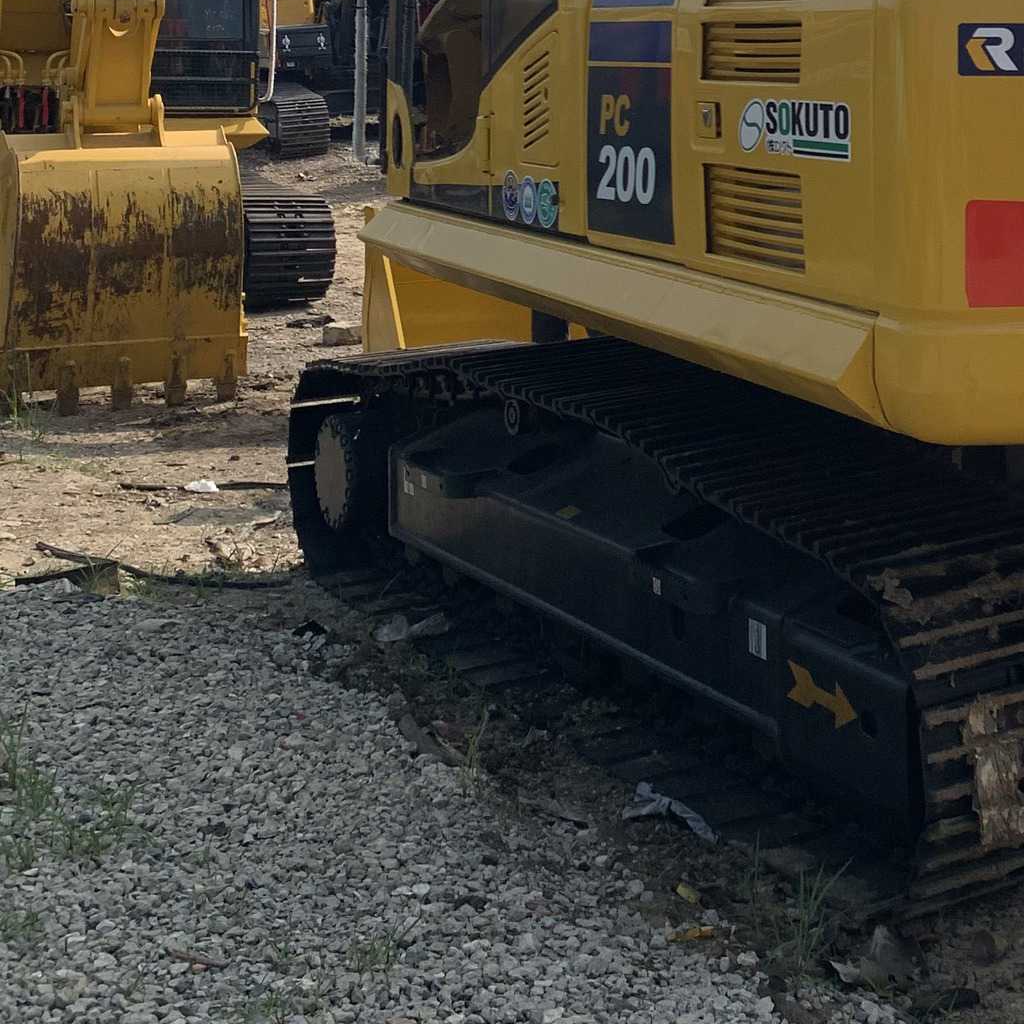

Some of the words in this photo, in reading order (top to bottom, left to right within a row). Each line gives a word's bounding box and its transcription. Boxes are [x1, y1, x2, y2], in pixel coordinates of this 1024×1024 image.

[600, 94, 631, 136] PC
[765, 101, 849, 140] SOKUTO
[596, 144, 656, 204] 200
